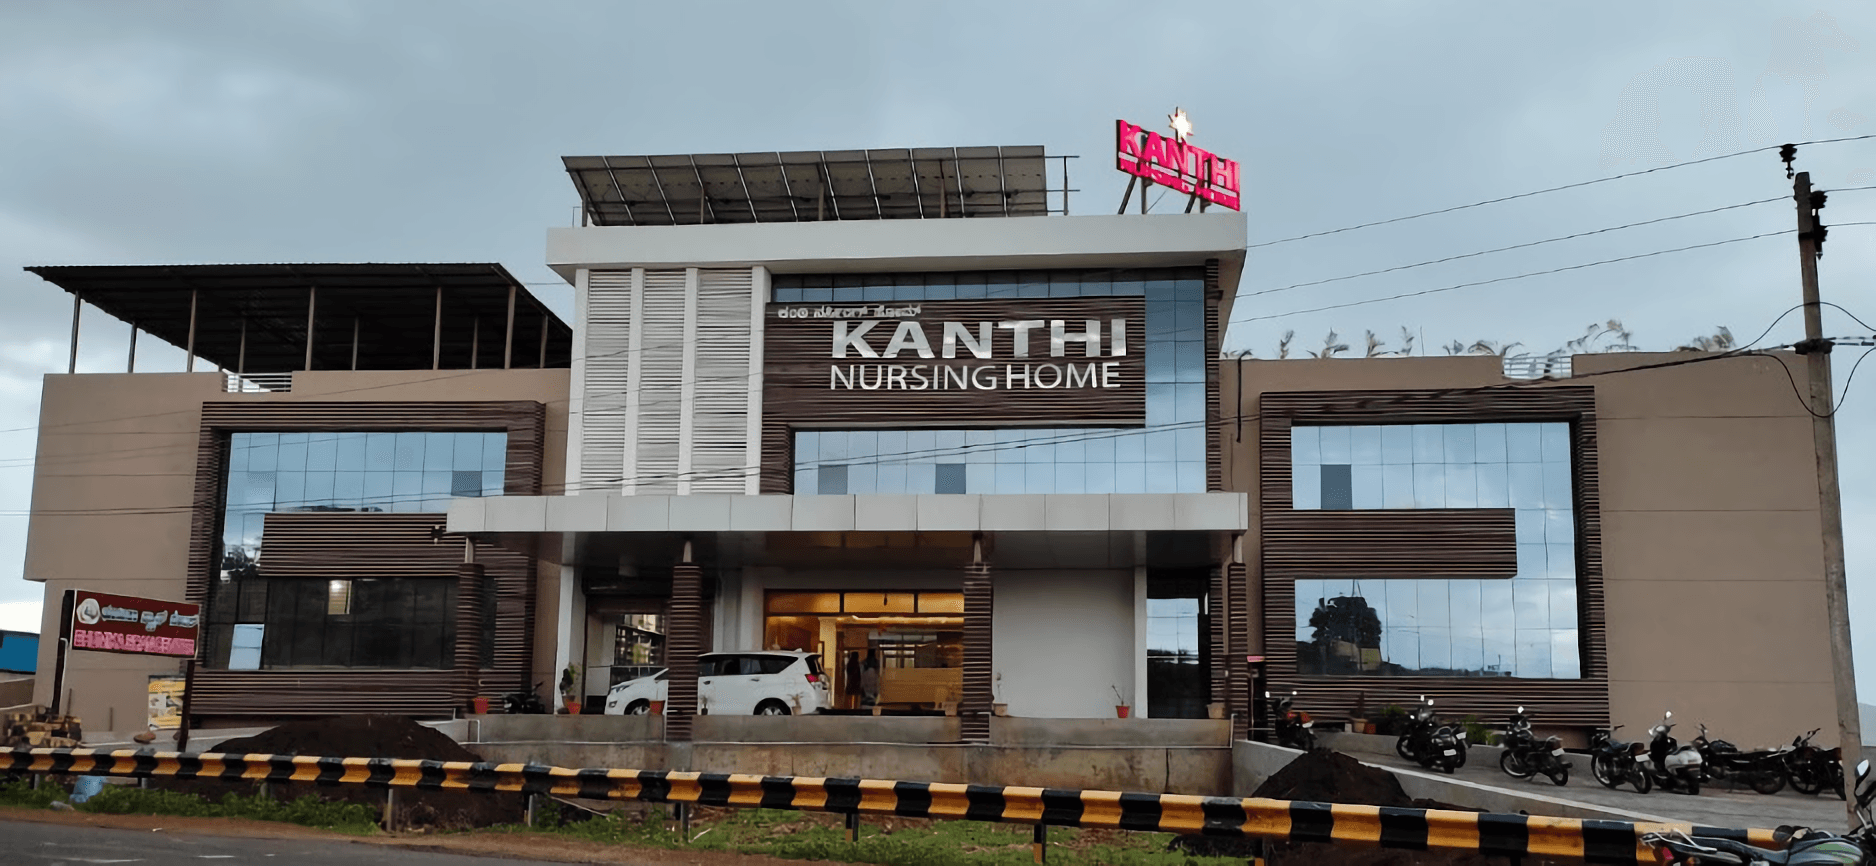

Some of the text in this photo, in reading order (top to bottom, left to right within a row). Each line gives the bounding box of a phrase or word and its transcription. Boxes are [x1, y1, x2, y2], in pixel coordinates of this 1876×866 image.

[1119, 119, 1240, 193] KANTHI
[831, 319, 1127, 358] KANTHI
[830, 361, 1122, 390] NURSING HOME
